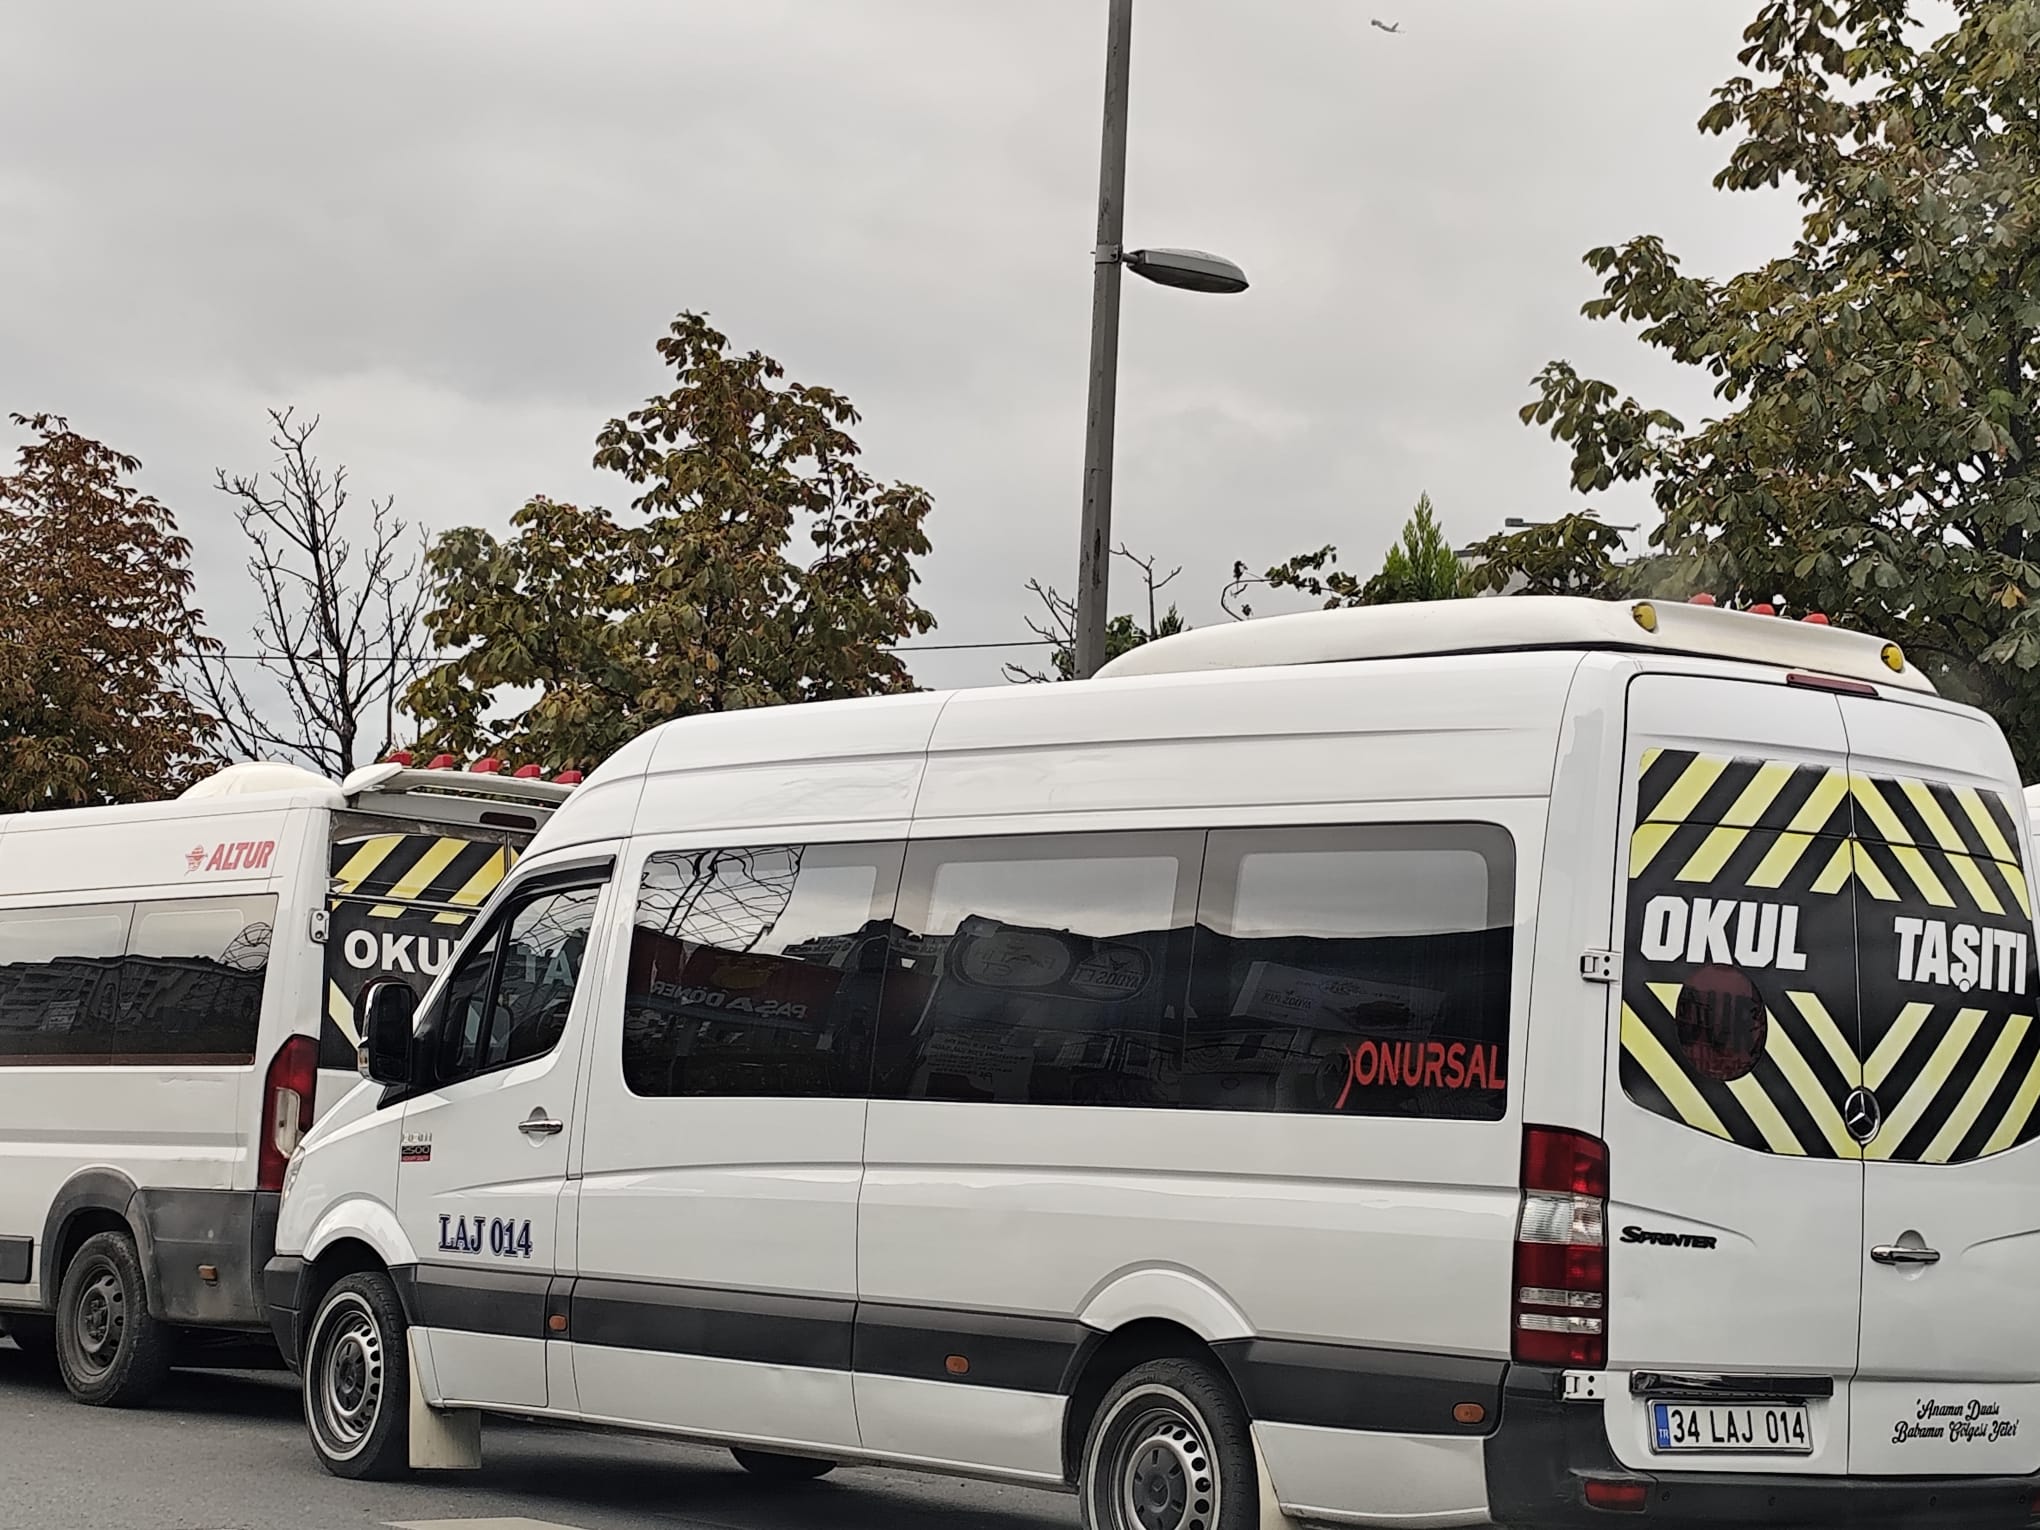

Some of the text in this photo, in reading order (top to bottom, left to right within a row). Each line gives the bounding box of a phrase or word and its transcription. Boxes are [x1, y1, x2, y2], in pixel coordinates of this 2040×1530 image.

[204, 841, 275, 871] ALTUR
[344, 929, 575, 987] OKU TA
[1641, 894, 2028, 995] OKUL TAŞITI
[1355, 1040, 1506, 1089] ONURSAL
[439, 1213, 533, 1258] LAJ 014
[1658, 1409, 1805, 1444] TR 34 LAJ 014
